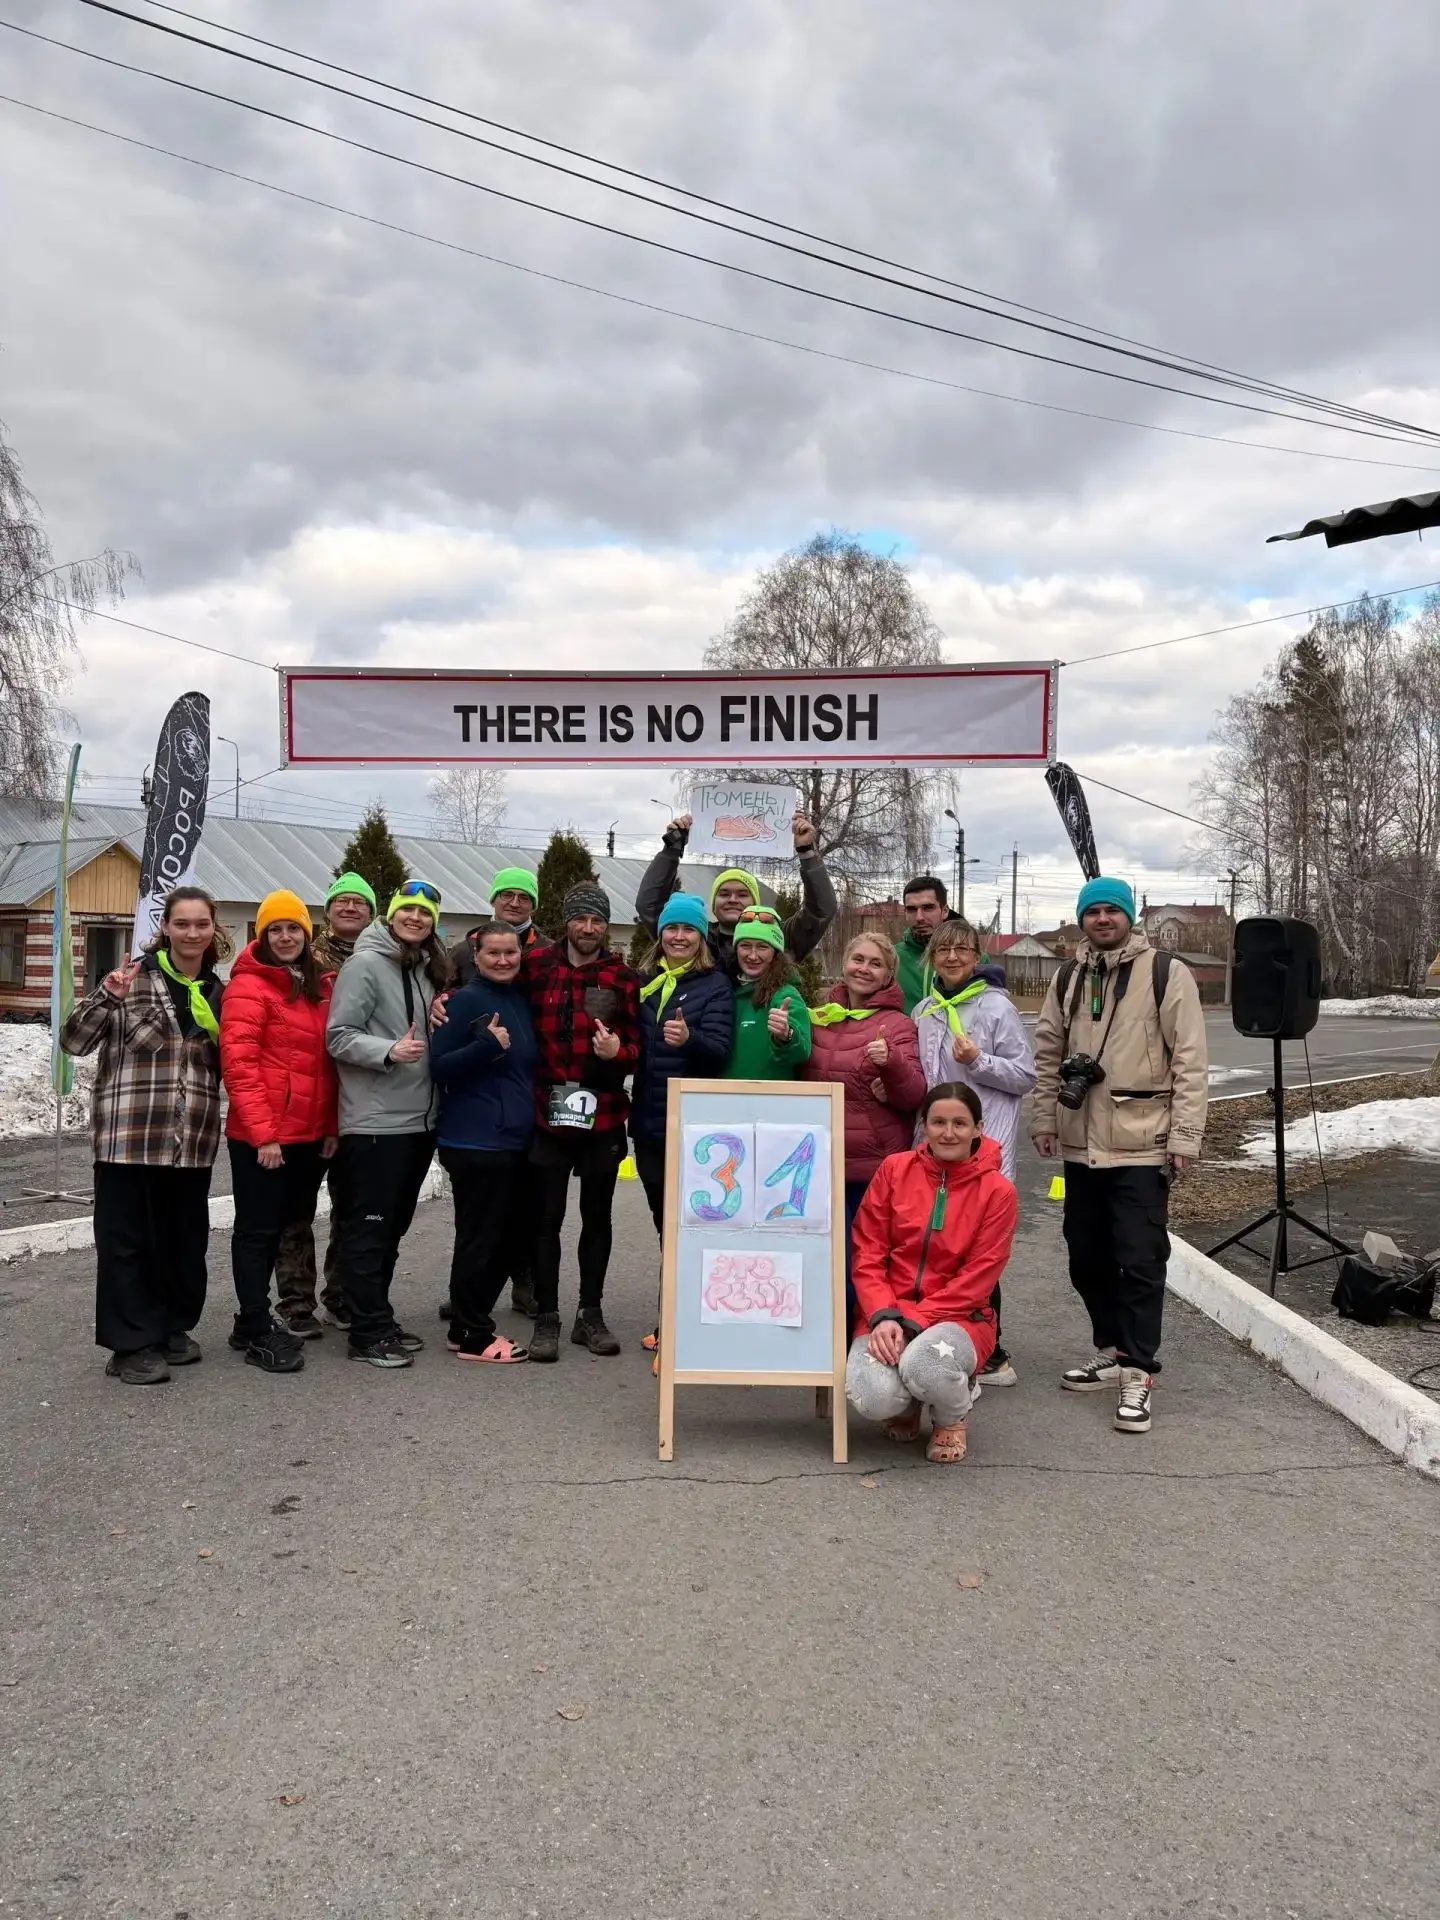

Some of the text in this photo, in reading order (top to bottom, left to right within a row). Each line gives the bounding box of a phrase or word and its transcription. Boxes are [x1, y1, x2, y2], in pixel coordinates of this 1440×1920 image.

[454, 694, 879, 743] THERE IS NO FINISH
[693, 785, 777, 812] ТЮМЕНЬ
[580, 1096, 587, 1115] 1
